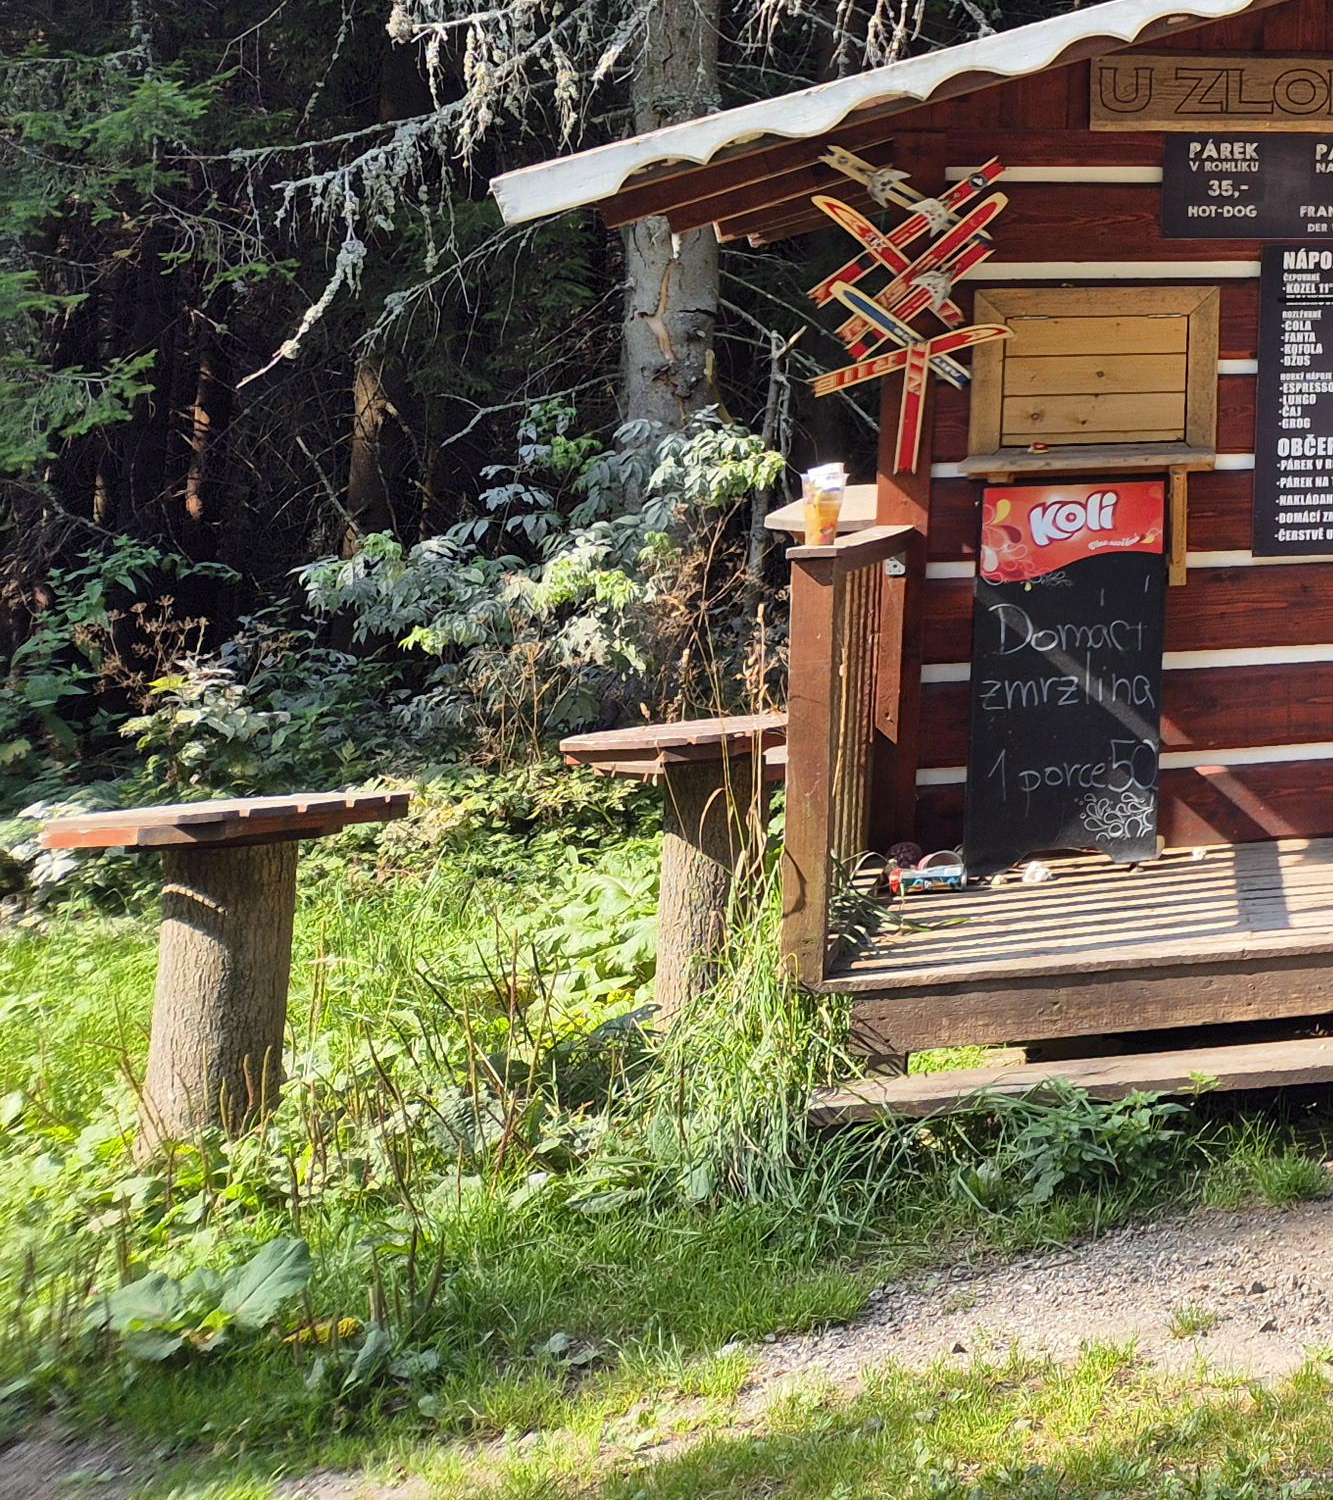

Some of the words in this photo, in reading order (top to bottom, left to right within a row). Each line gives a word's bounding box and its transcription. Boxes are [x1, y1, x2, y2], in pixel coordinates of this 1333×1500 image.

[1099, 67, 1154, 114] U
[1188, 138, 1260, 160] PÁREK
[1189, 162, 1199, 172] V
[1204, 160, 1260, 173] ROHLÍKU
[1207, 180, 1250, 199] 35,-
[1187, 205, 1258, 219] HOT-DOG
[1307, 223, 1329, 233] DER
[1315, 459, 1323, 470] V
[1315, 476, 1329, 487] NA
